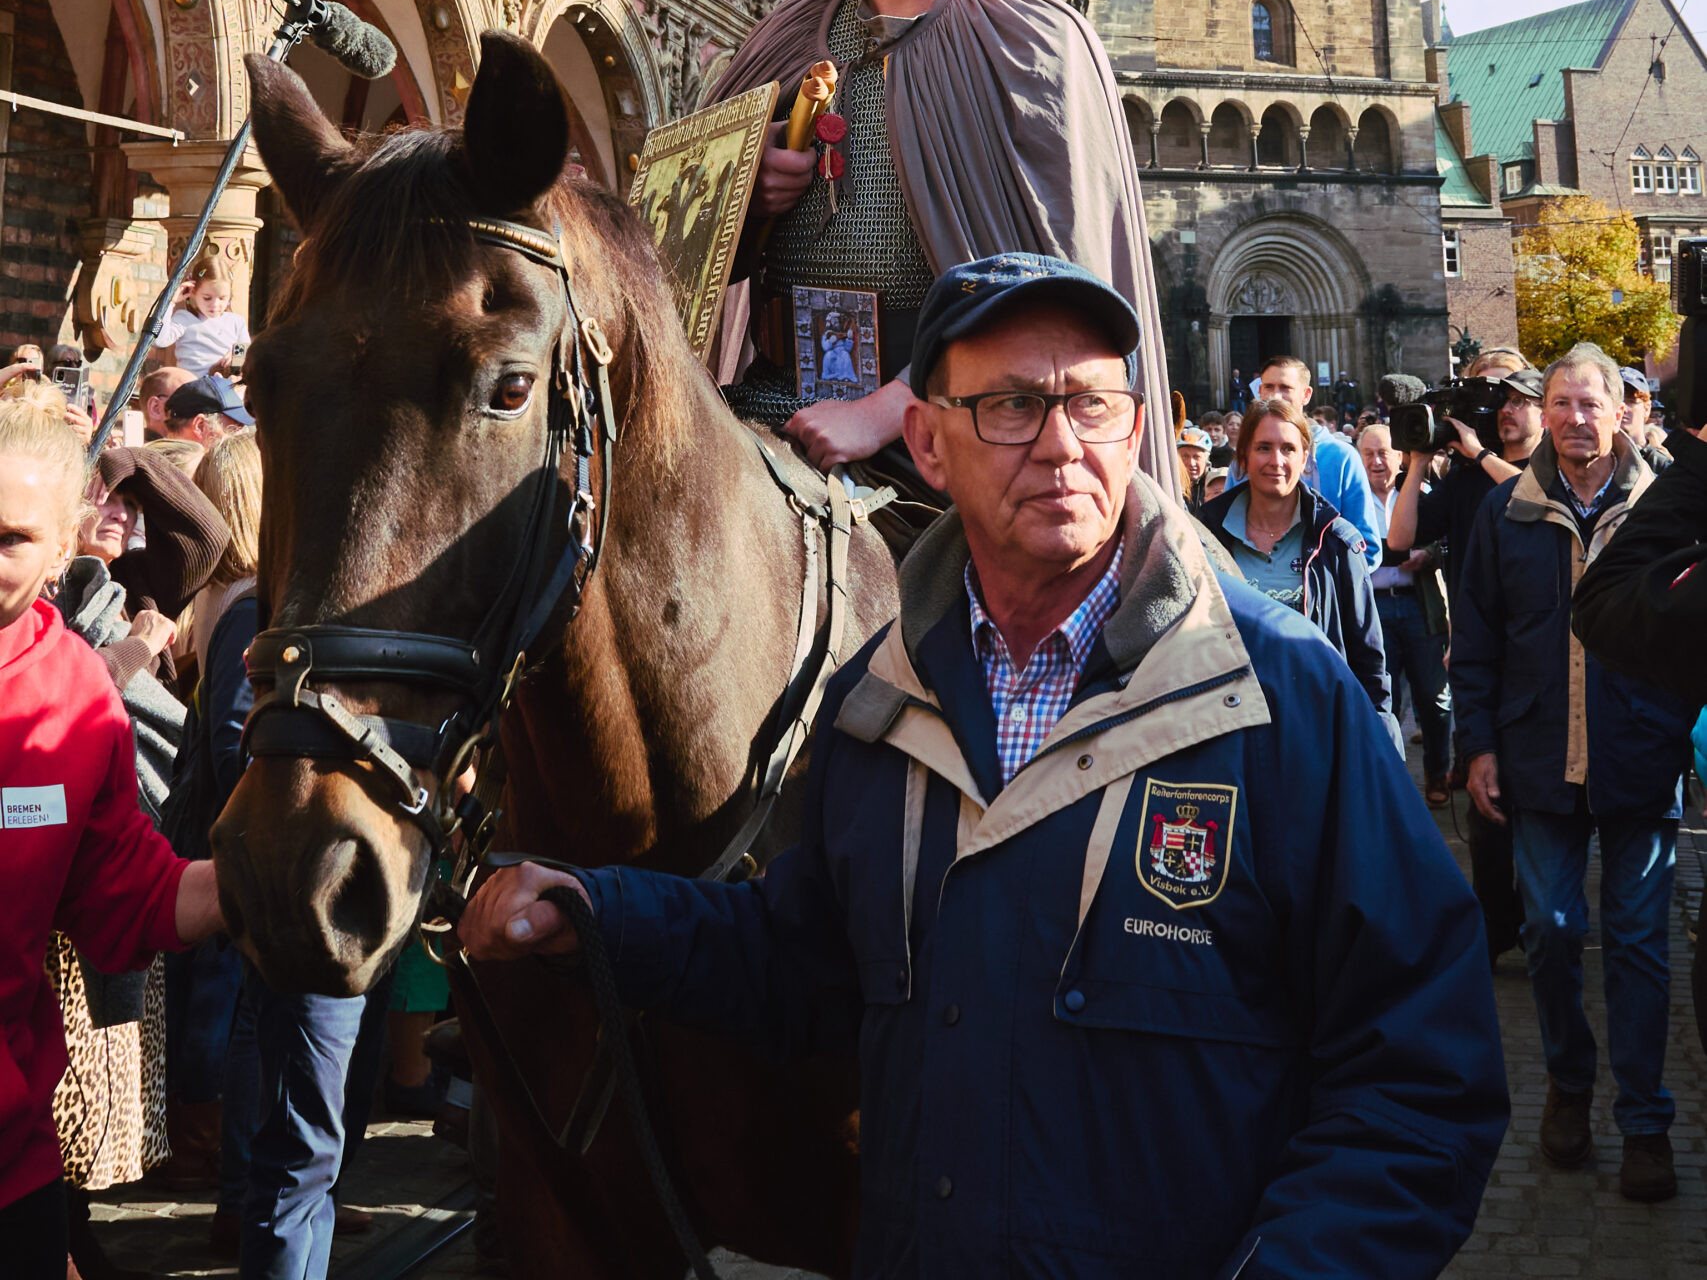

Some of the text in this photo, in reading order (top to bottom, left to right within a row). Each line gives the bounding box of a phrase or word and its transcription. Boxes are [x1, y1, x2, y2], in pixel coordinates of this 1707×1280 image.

[1151, 785, 1230, 805] Reiterfanfarencorps
[7, 804, 42, 814] BREMEN
[7, 813, 50, 825] ERLEBEN!
[1190, 884, 1211, 896] e.V.
[1124, 917, 1213, 946] EUROHORSE
